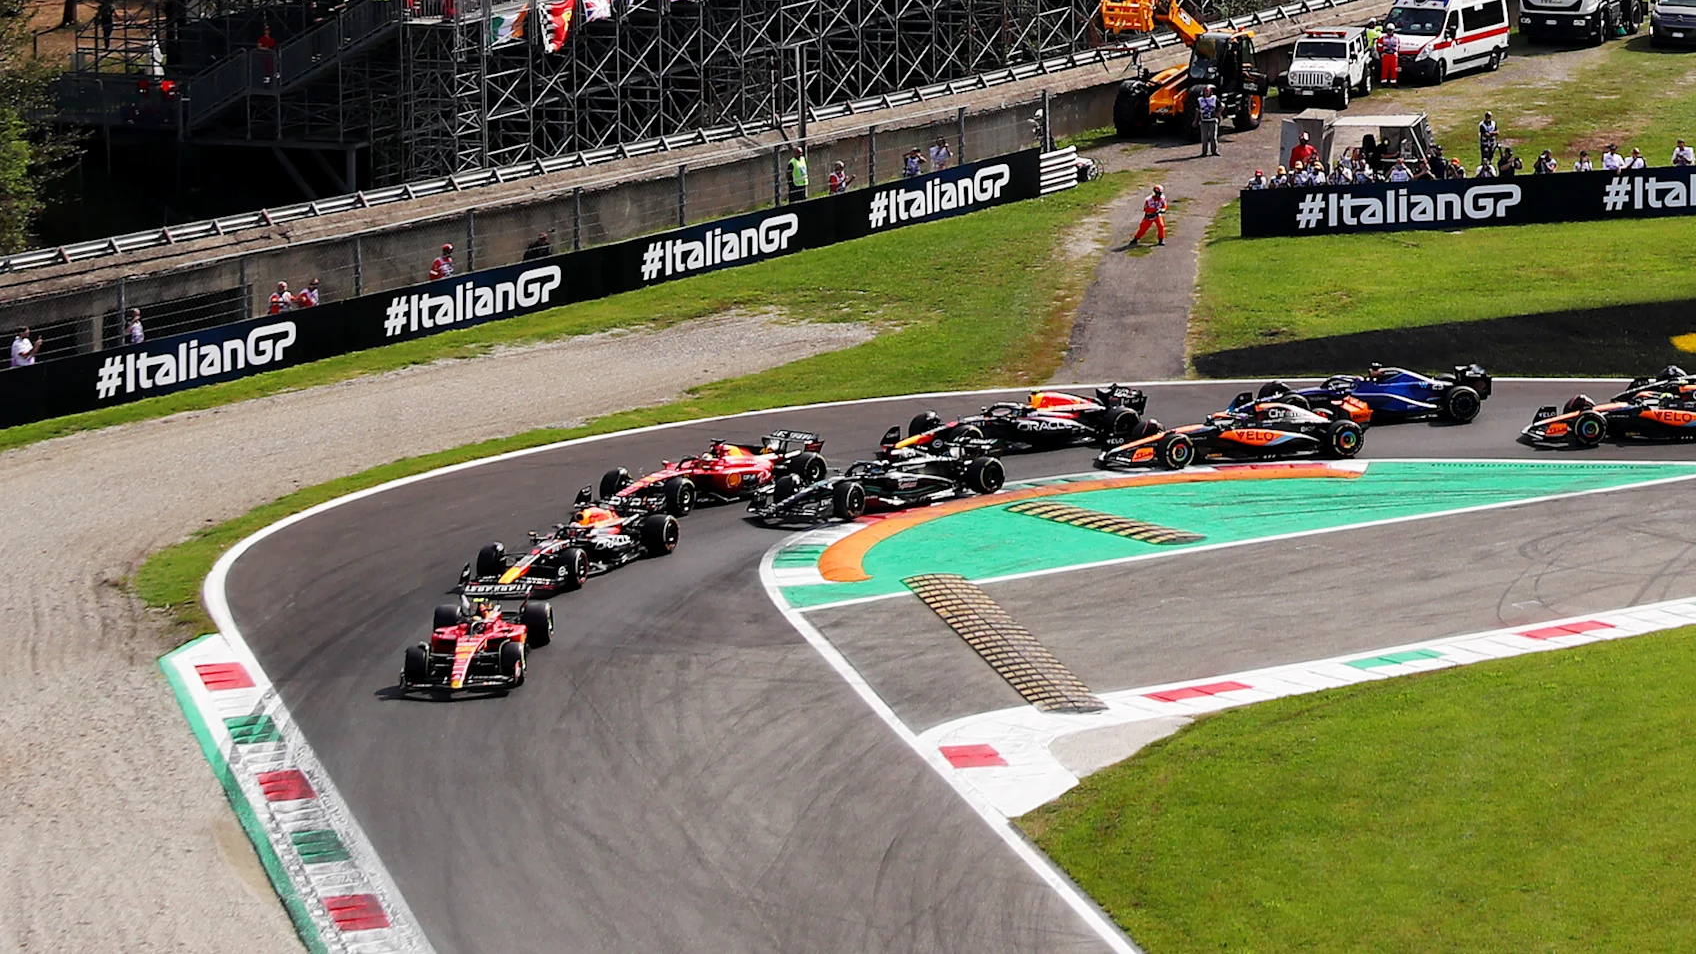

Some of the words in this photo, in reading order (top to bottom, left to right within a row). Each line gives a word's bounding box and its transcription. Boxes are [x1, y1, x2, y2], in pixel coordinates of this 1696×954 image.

[869, 164, 1010, 229] #ItalianGP
[1296, 183, 1521, 228] #ItalianGP
[641, 213, 798, 281] #ItalianGP
[384, 265, 562, 337] #ItalianGP
[97, 321, 297, 399] #ItalianGP
[1017, 419, 1074, 431] ORACLE
[1235, 431, 1275, 442] VELO
[1654, 411, 1692, 423] VELO
